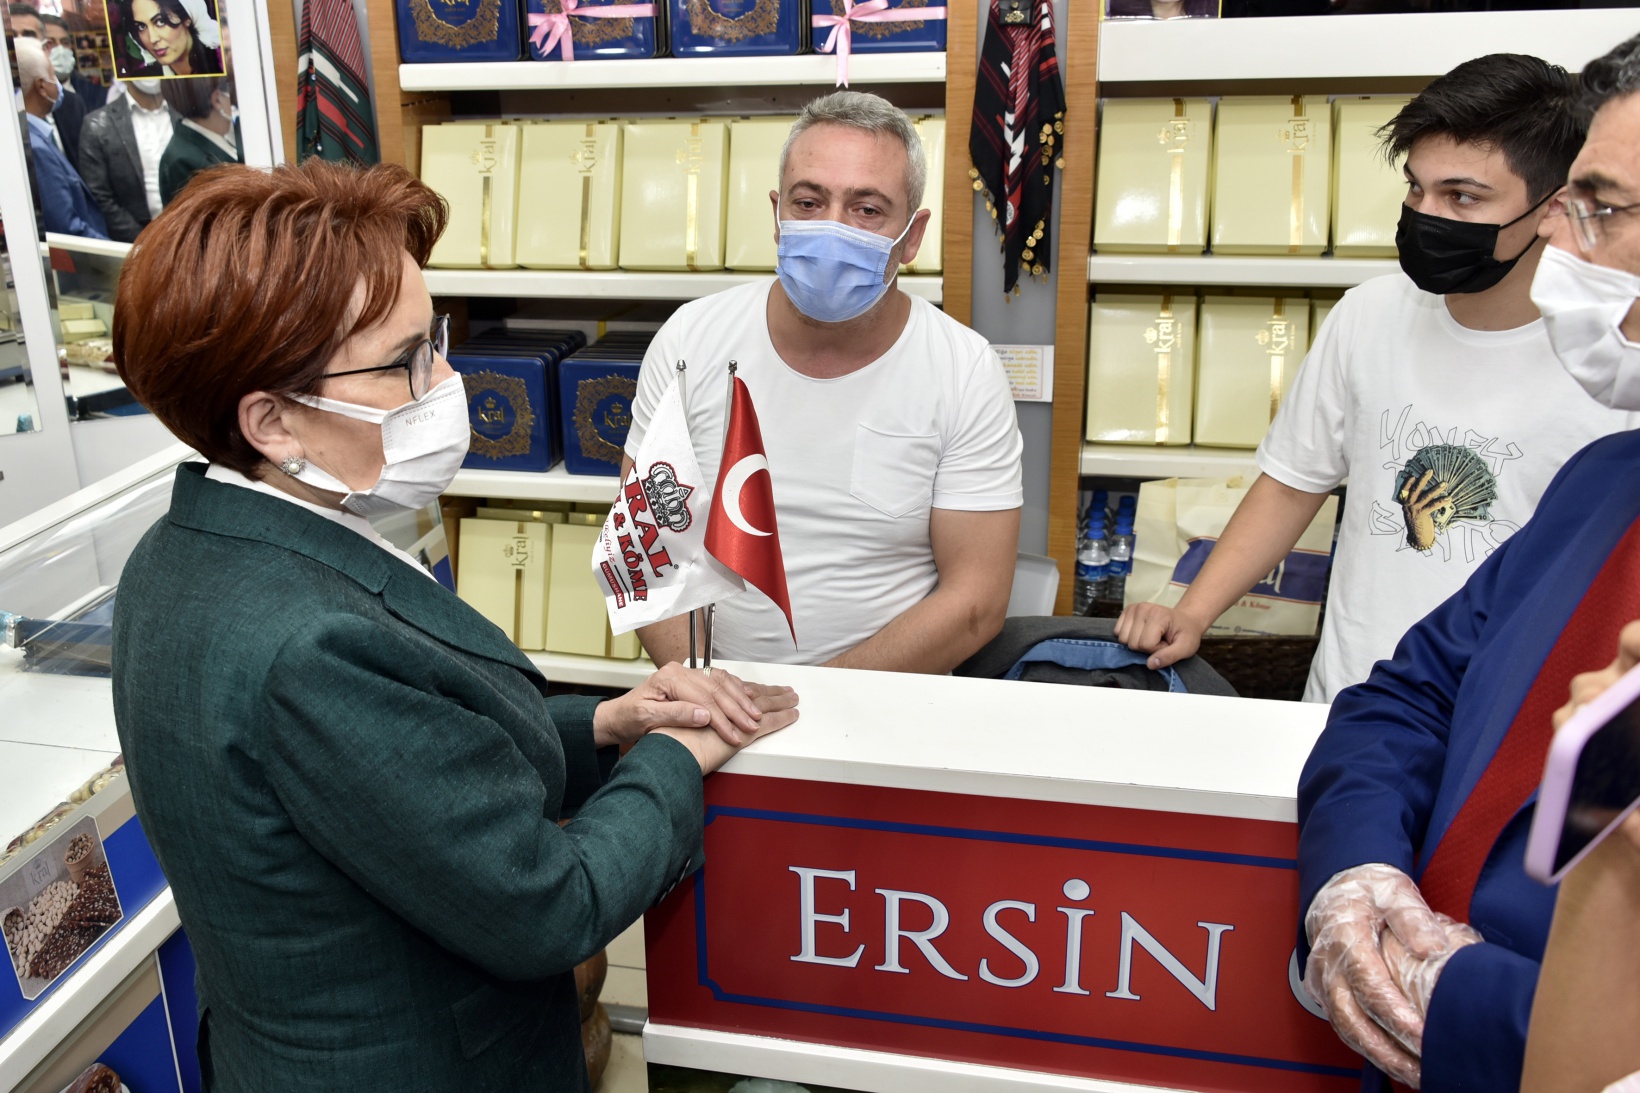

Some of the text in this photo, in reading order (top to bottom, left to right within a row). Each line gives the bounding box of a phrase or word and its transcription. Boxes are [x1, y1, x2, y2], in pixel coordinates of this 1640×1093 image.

[1167, 118, 1190, 152] kral
[1287, 118, 1310, 152] kral
[478, 140, 497, 174] kral
[578, 140, 597, 173] kral
[1153, 318, 1176, 353] kral
[1266, 319, 1289, 355] kral
[405, 409, 436, 427] NFLEX
[478, 406, 505, 423] kral
[613, 512, 626, 531] &
[625, 457, 673, 578] RAL
[511, 536, 529, 567] kral
[617, 532, 648, 602] KÖME
[788, 865, 1235, 1012] ERSİN
